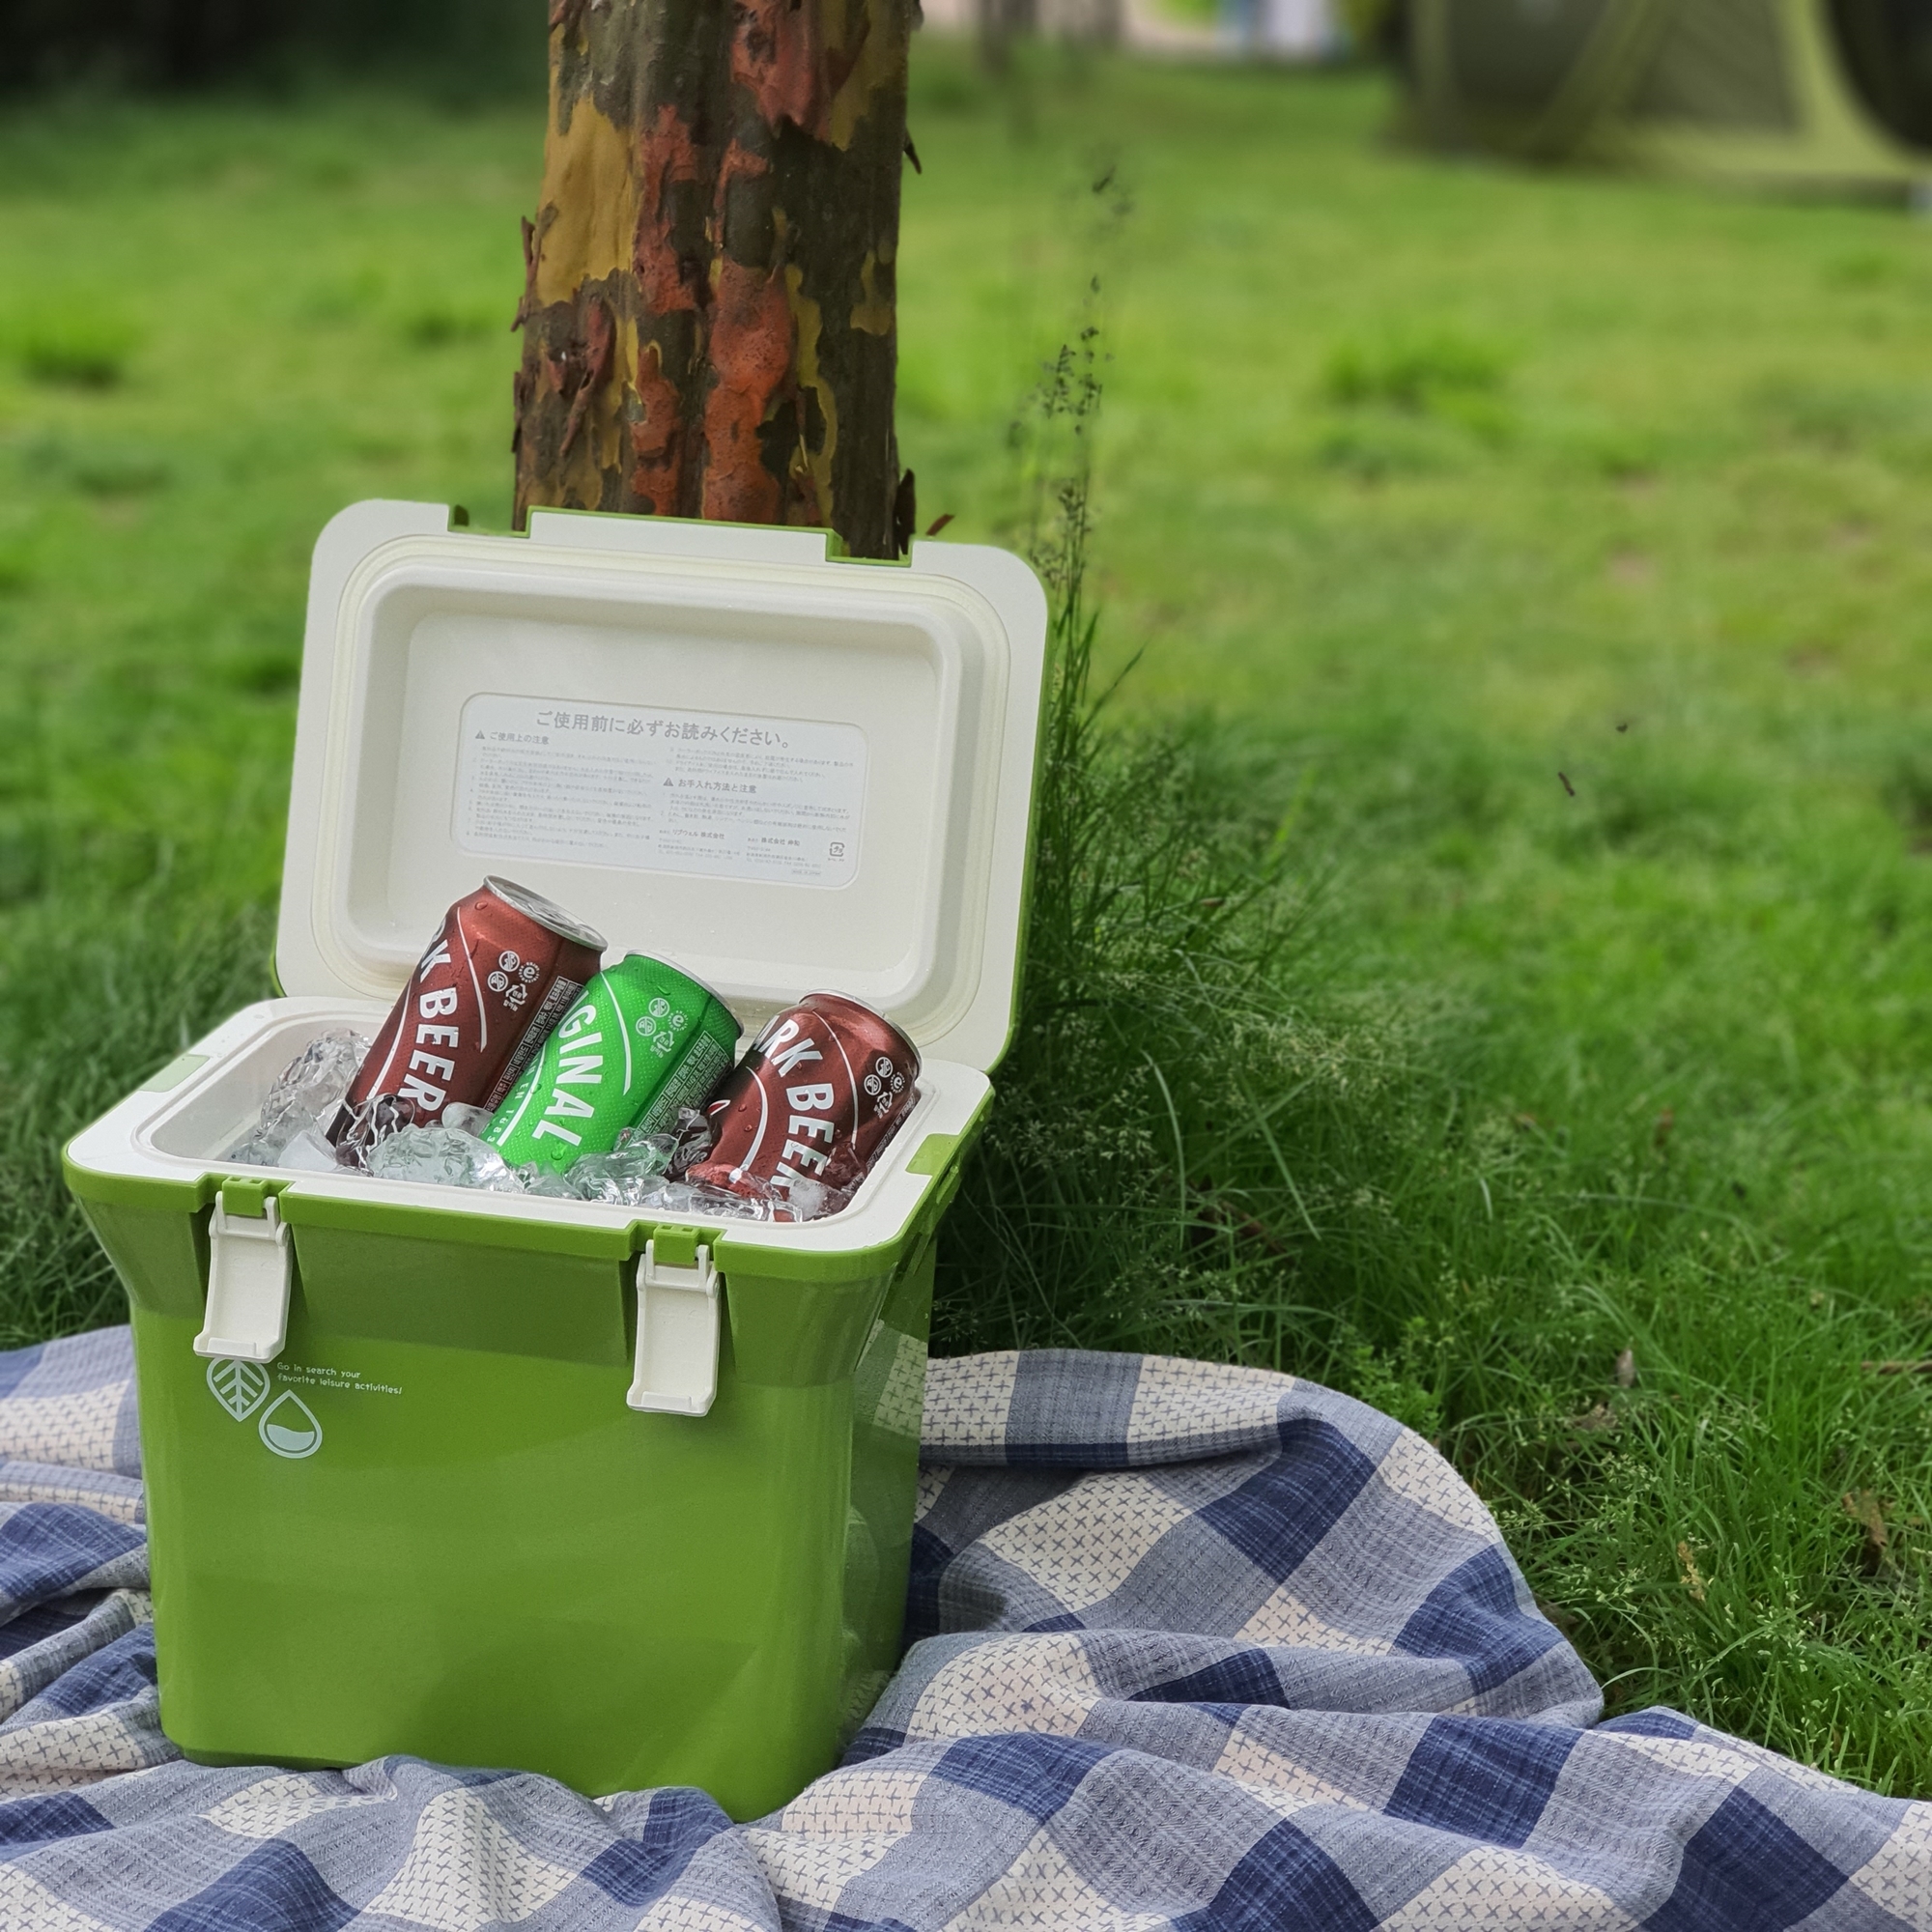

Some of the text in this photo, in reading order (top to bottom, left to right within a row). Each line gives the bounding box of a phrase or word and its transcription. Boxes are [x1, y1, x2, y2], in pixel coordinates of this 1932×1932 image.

[489, 730, 550, 746] ご使用上の注意
[535, 710, 790, 749] ご使用前に必ずお読みください。
[678, 777, 757, 794] お手入れ方法と注意
[398, 986, 459, 1112] BEER
[277, 1362, 290, 1371] Go
[306, 1366, 336, 1376] search
[341, 1370, 361, 1378] your
[277, 1373, 402, 1394] favorite leisure activities!
